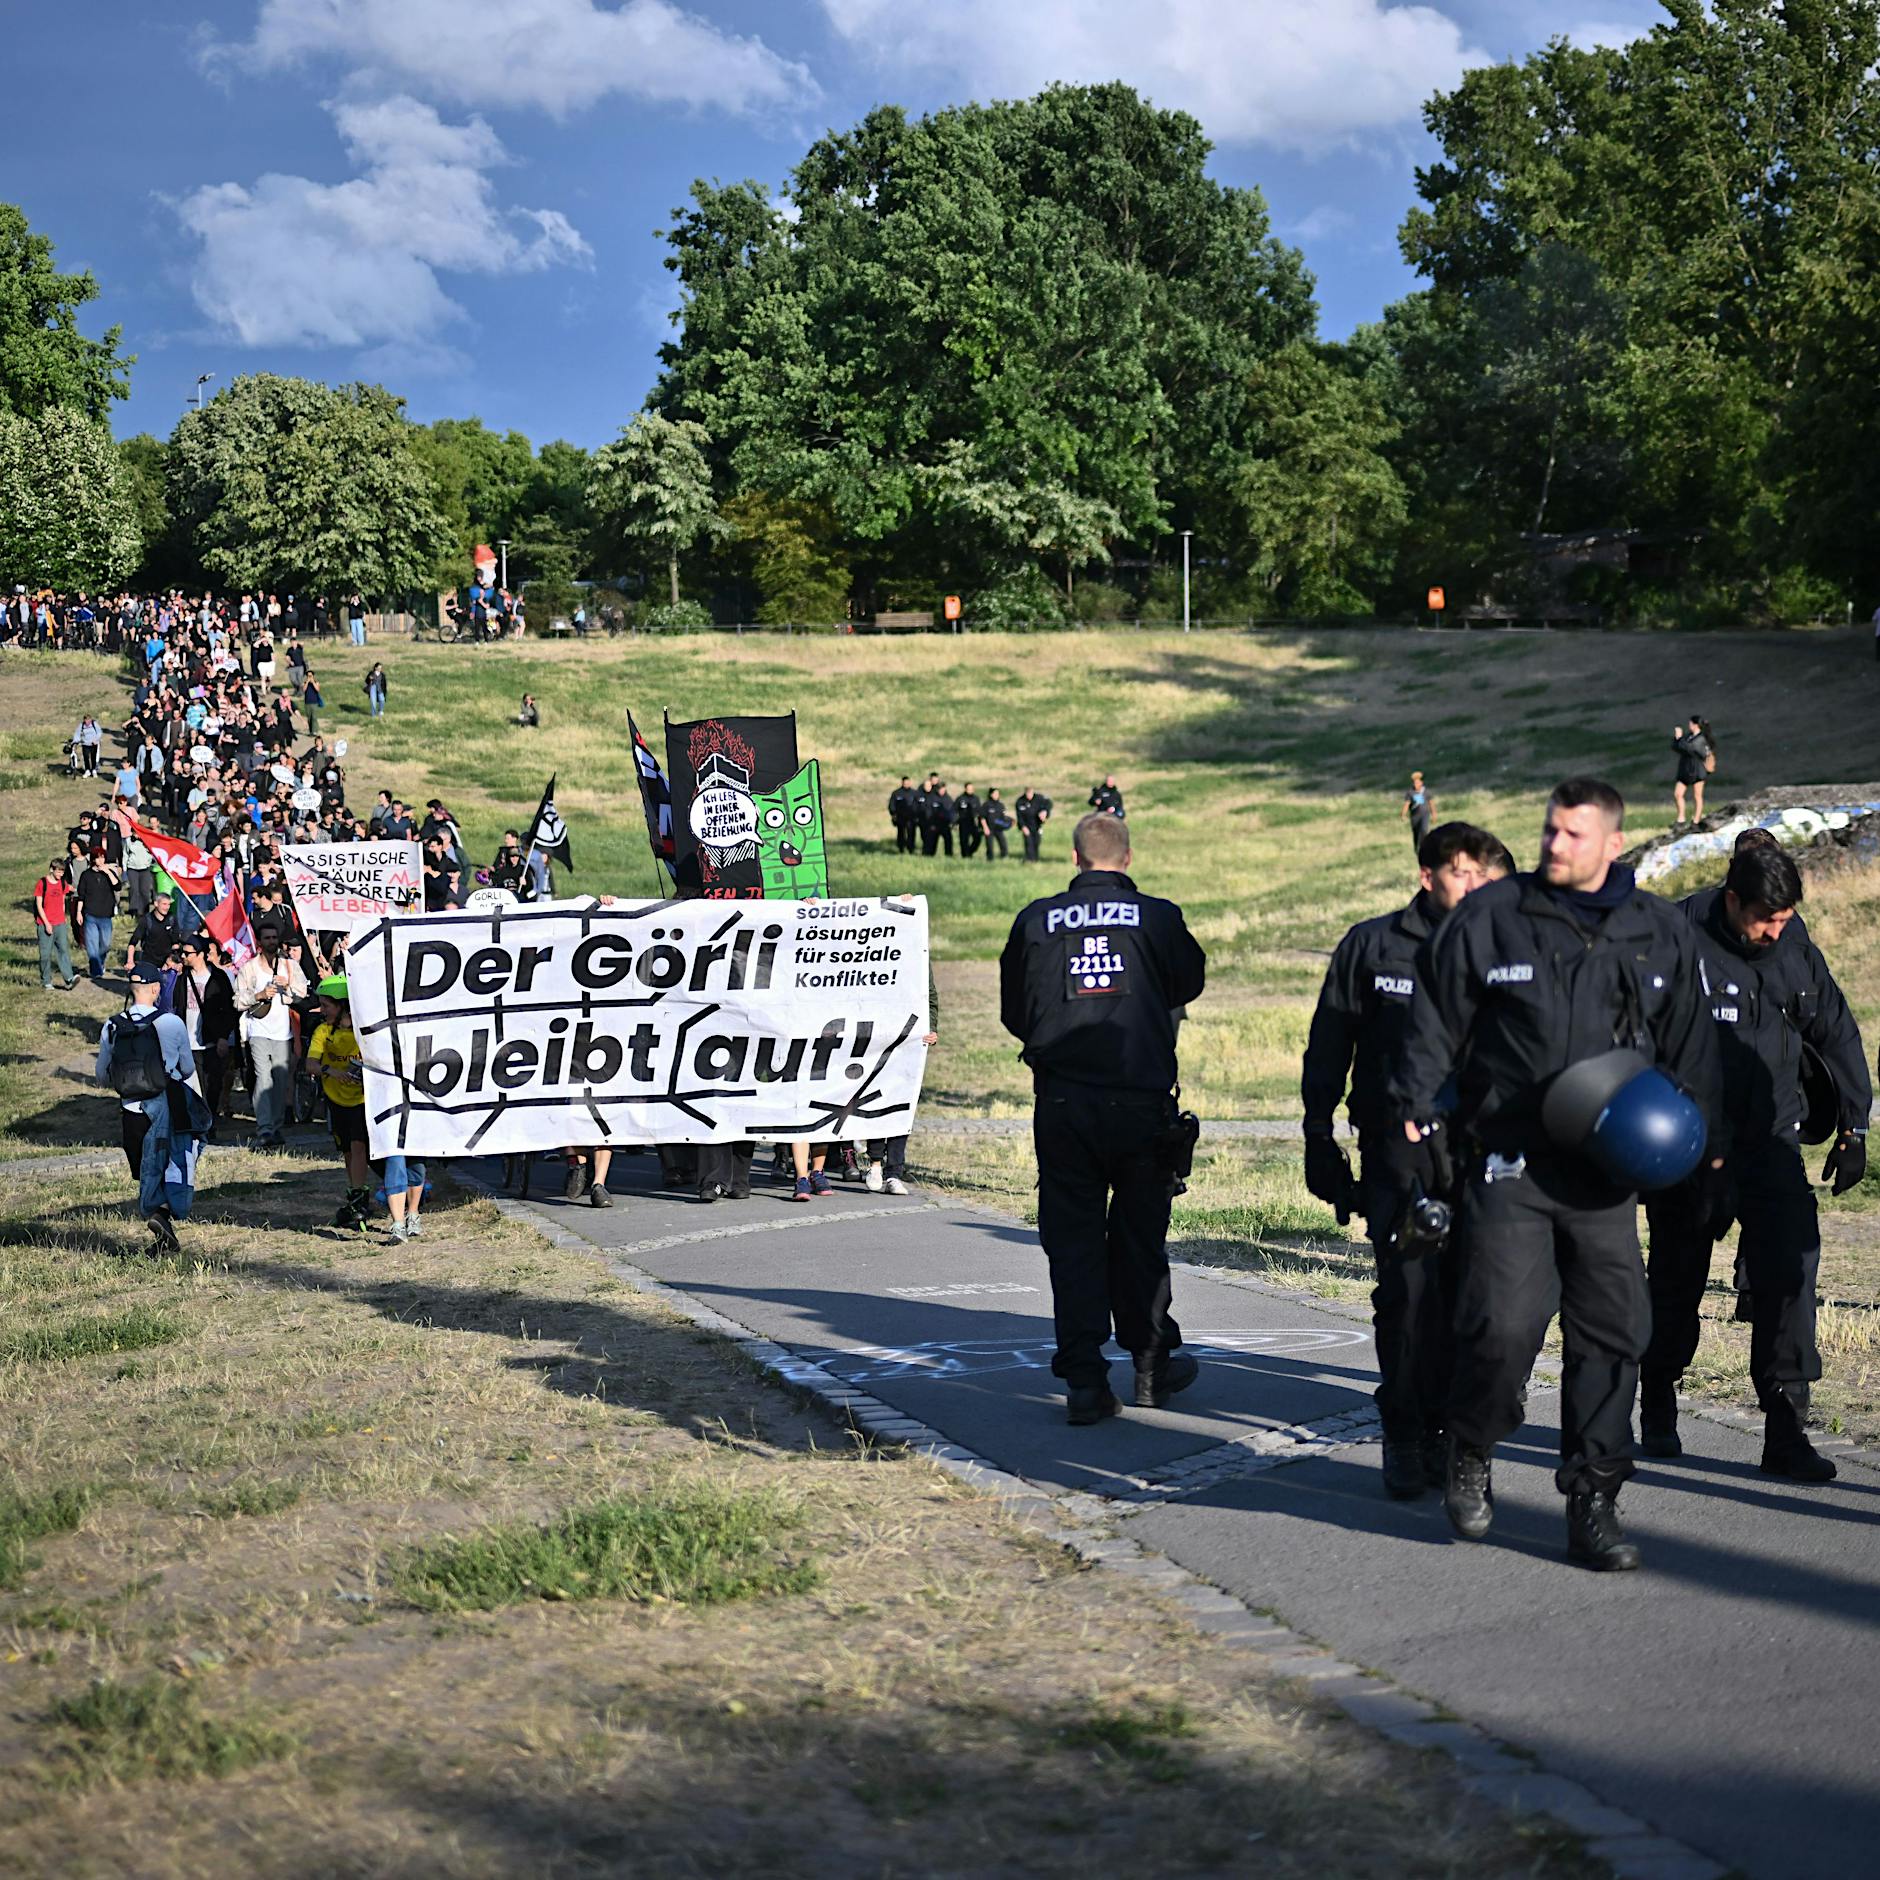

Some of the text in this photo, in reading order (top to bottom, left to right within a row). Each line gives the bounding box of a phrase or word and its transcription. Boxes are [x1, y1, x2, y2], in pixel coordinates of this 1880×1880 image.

[703, 791, 737, 804] ICH LEBE
[704, 802, 740, 815] IN EINER
[706, 812, 746, 826] OFFENEN
[701, 822, 753, 839] BEZIEHUNG
[283, 852, 409, 867] RASSISTISCHE
[317, 868, 383, 883] ZÄUNE
[295, 882, 409, 901] ZERSTÖREN
[320, 899, 387, 914] LEBEN
[795, 901, 869, 919] soziale
[1047, 902, 1140, 933] POLIZEI
[795, 925, 896, 945] Lösungen
[795, 946, 901, 963] für soziale
[1083, 936, 1109, 955] BE
[402, 924, 783, 1002] Der Görli
[1070, 954, 1124, 974] 22111
[795, 969, 897, 988] Konflikte!
[1487, 964, 1533, 984] POLIZEI
[414, 1017, 874, 1097] bleibt auf!
